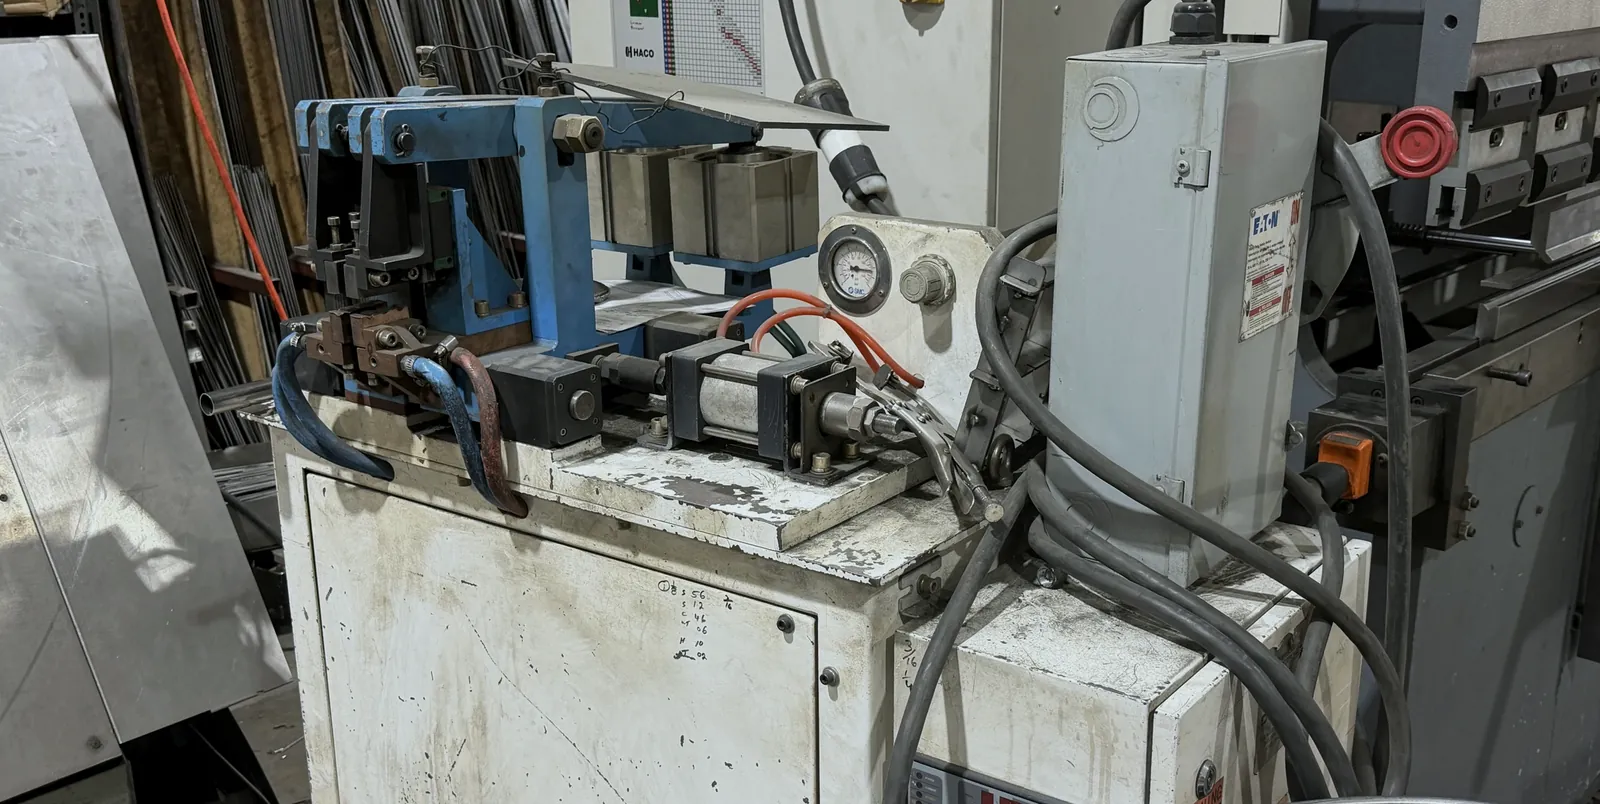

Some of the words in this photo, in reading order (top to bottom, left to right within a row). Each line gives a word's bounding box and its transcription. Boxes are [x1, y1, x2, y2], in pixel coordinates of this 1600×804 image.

[633, 48, 655, 58] HACO
[1290, 198, 1300, 226] ON
[902, 640, 917, 667] 3/16
